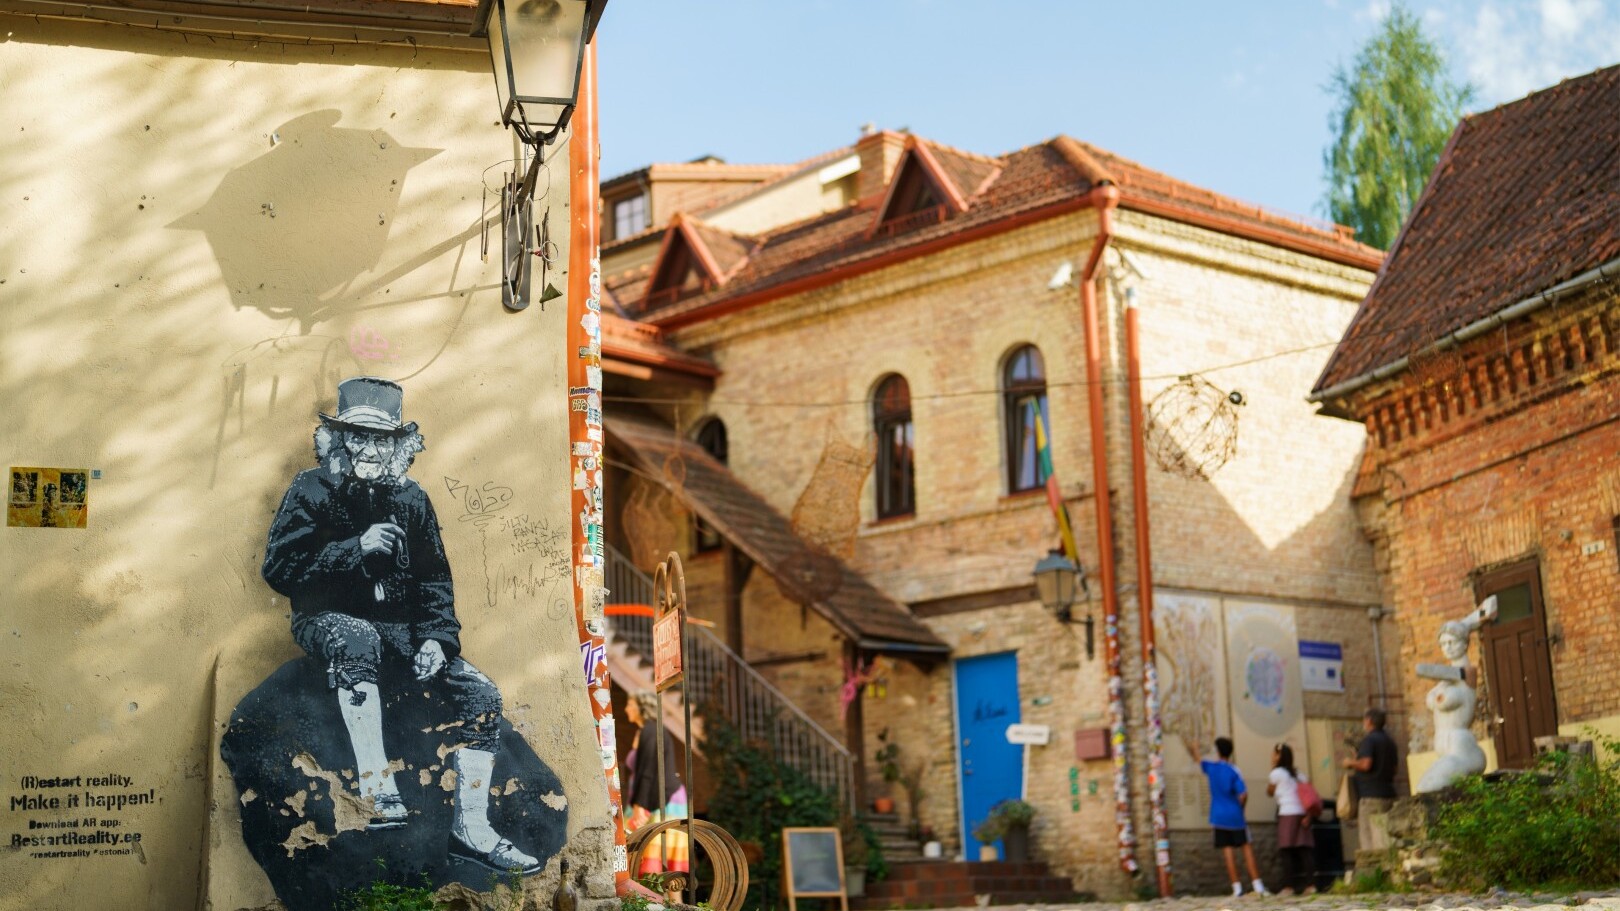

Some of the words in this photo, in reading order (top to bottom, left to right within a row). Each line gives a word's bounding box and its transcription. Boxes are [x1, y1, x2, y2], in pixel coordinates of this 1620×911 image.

[21, 775, 82, 790] (R)estart
[86, 774, 133, 787] reality.
[10, 794, 60, 811] Make
[67, 794, 79, 808] it
[85, 788, 155, 811] happen!
[29, 819, 79, 830] Download
[82, 818, 97, 828] AR
[11, 831, 142, 847] RestartReality.ee
